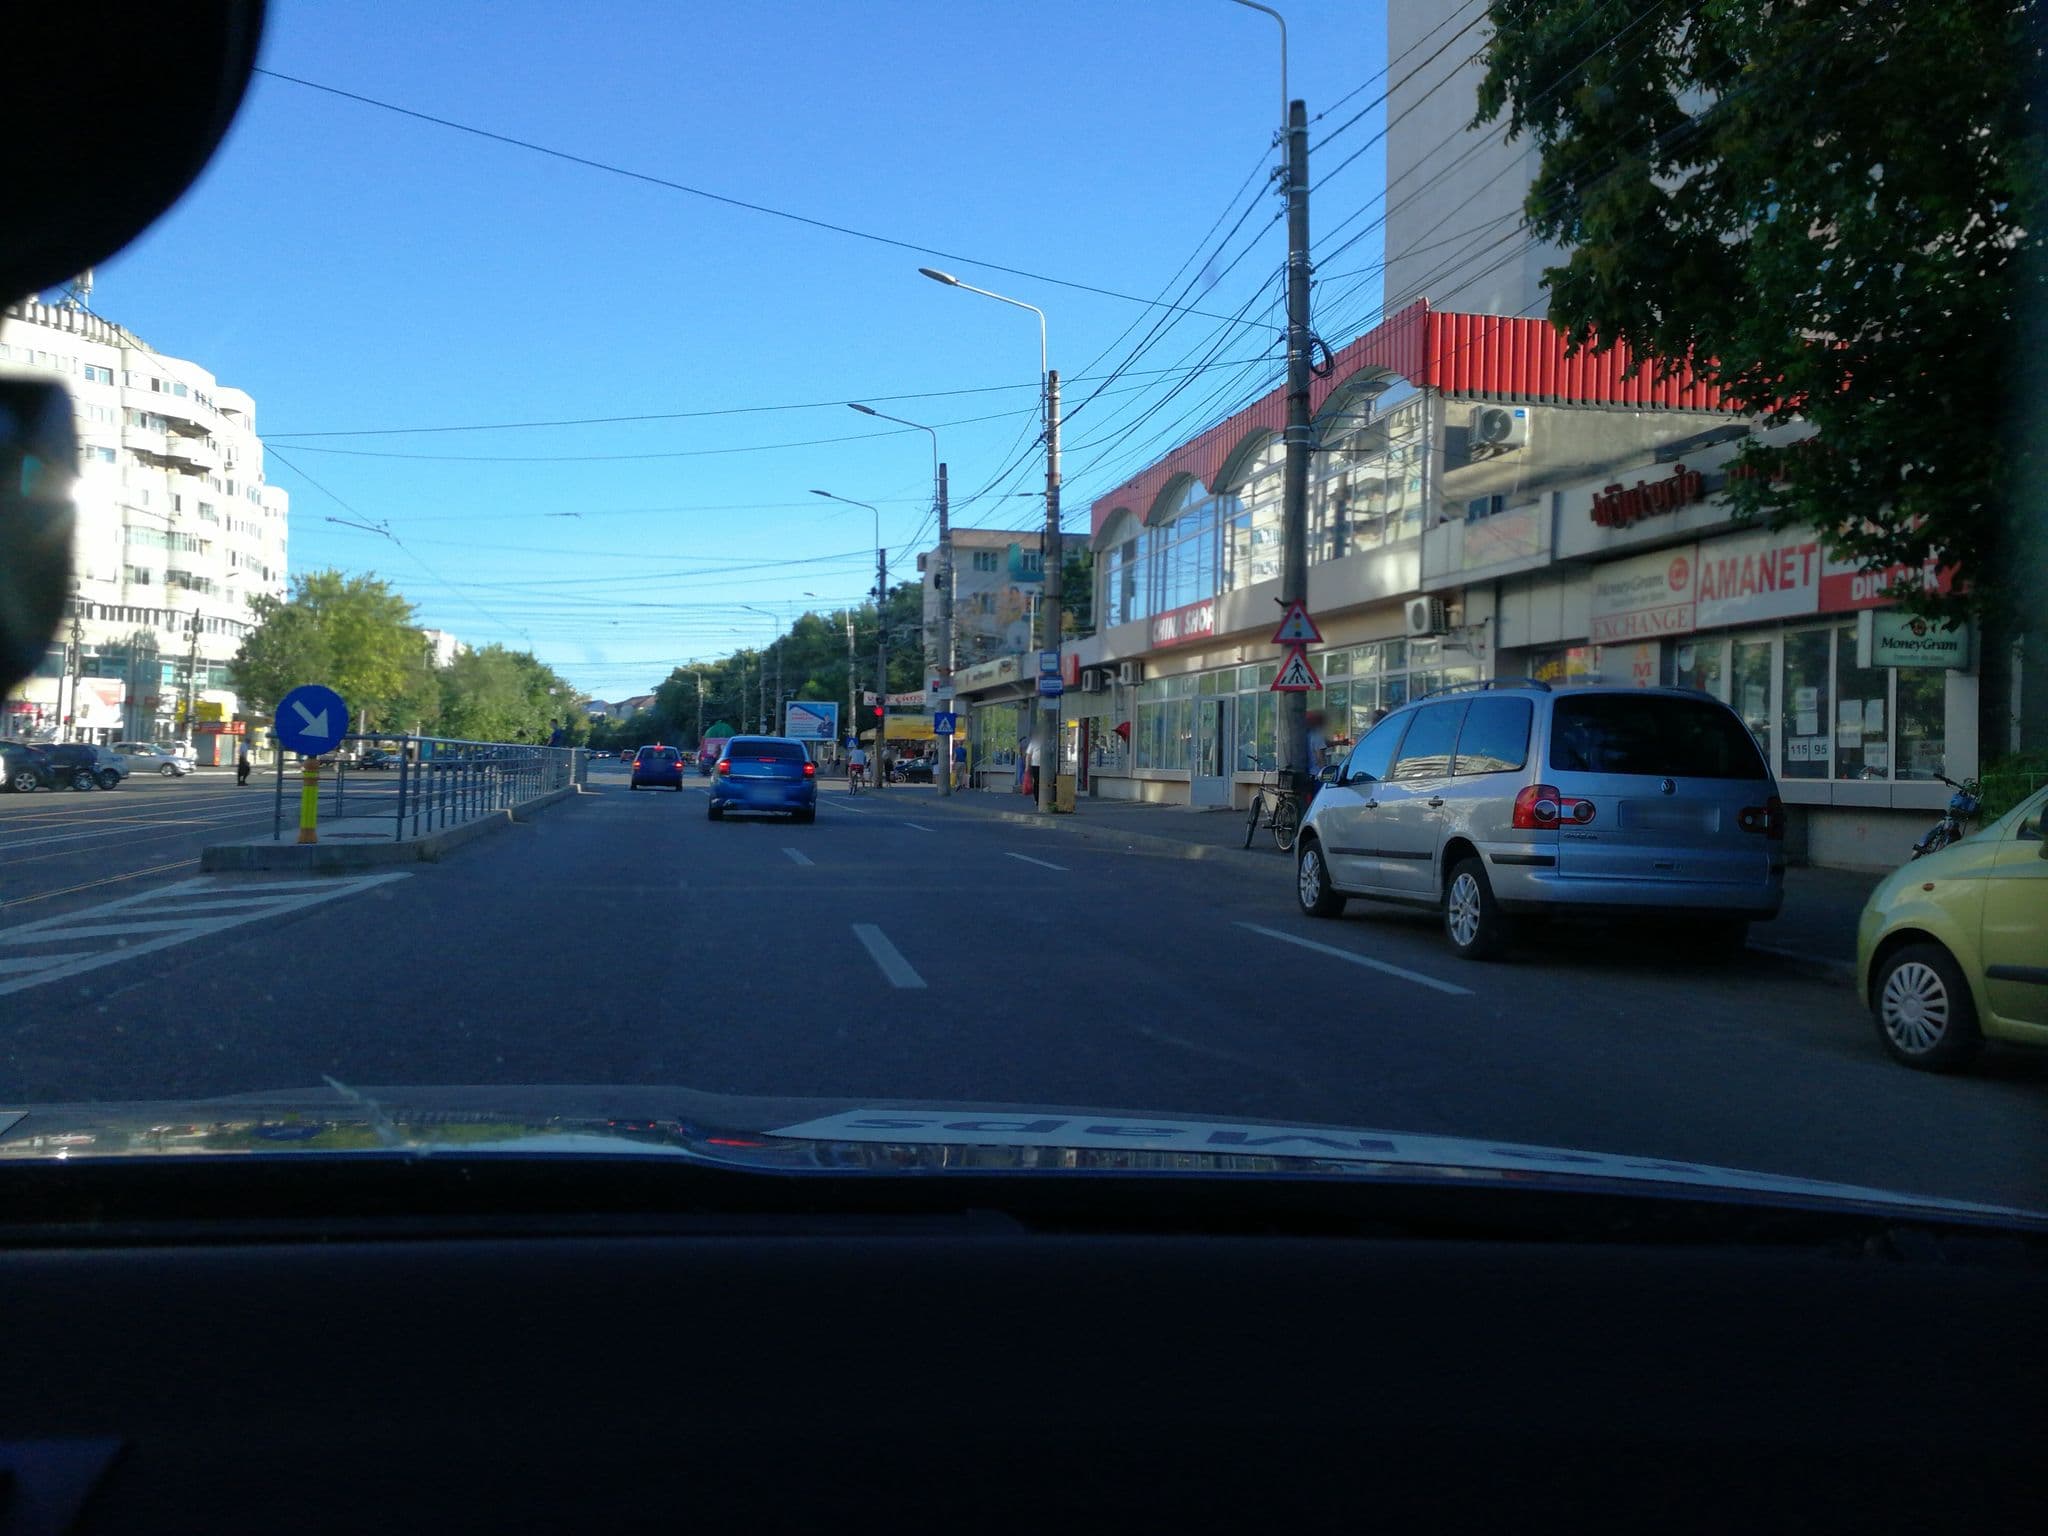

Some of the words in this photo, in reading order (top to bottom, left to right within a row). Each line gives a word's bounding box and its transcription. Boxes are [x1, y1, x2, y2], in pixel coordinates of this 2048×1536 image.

[1699, 544, 1817, 602] AMANET
[1593, 608, 1688, 641] EXCHANGE
[1881, 637, 1958, 652] MoneyGram
[843, 1119, 1400, 1154] Maps
